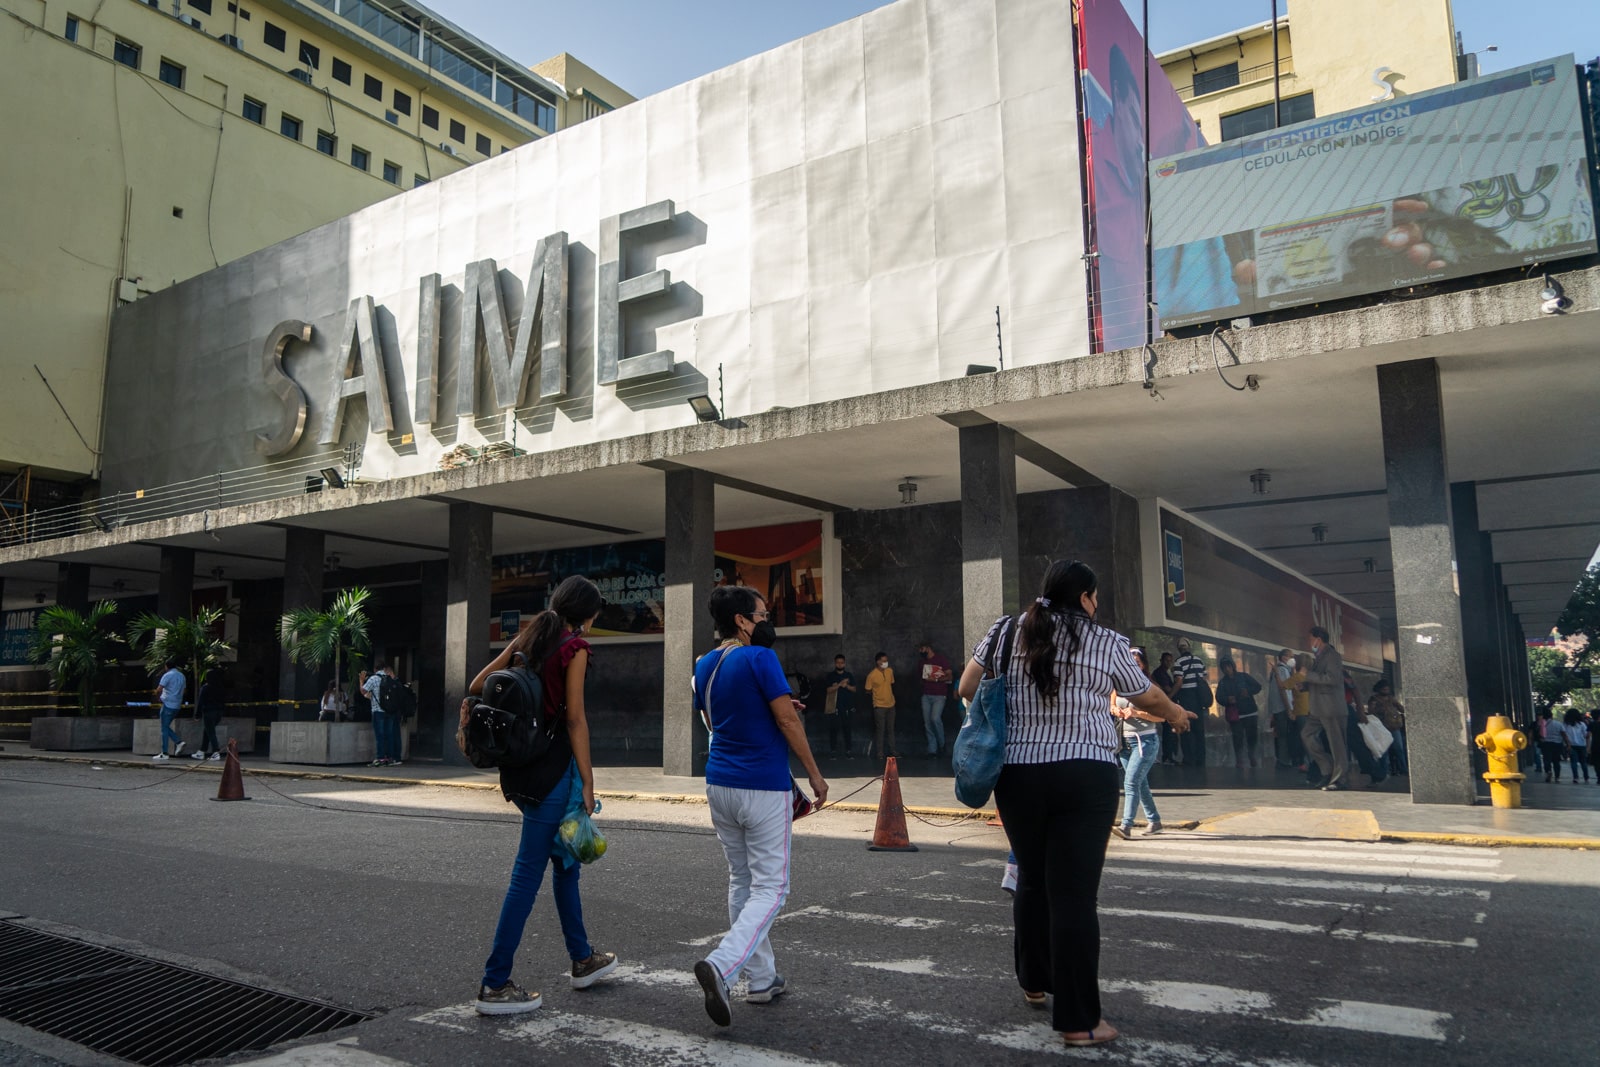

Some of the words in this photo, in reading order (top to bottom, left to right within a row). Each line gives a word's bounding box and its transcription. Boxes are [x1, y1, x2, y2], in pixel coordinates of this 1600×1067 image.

[1263, 104, 1411, 152] IDENTIFICACIÓN
[254, 198, 676, 456] SAIME
[604, 587, 651, 604] GULLOSO
[611, 577, 625, 590] DE
[626, 573, 656, 588] CADA
